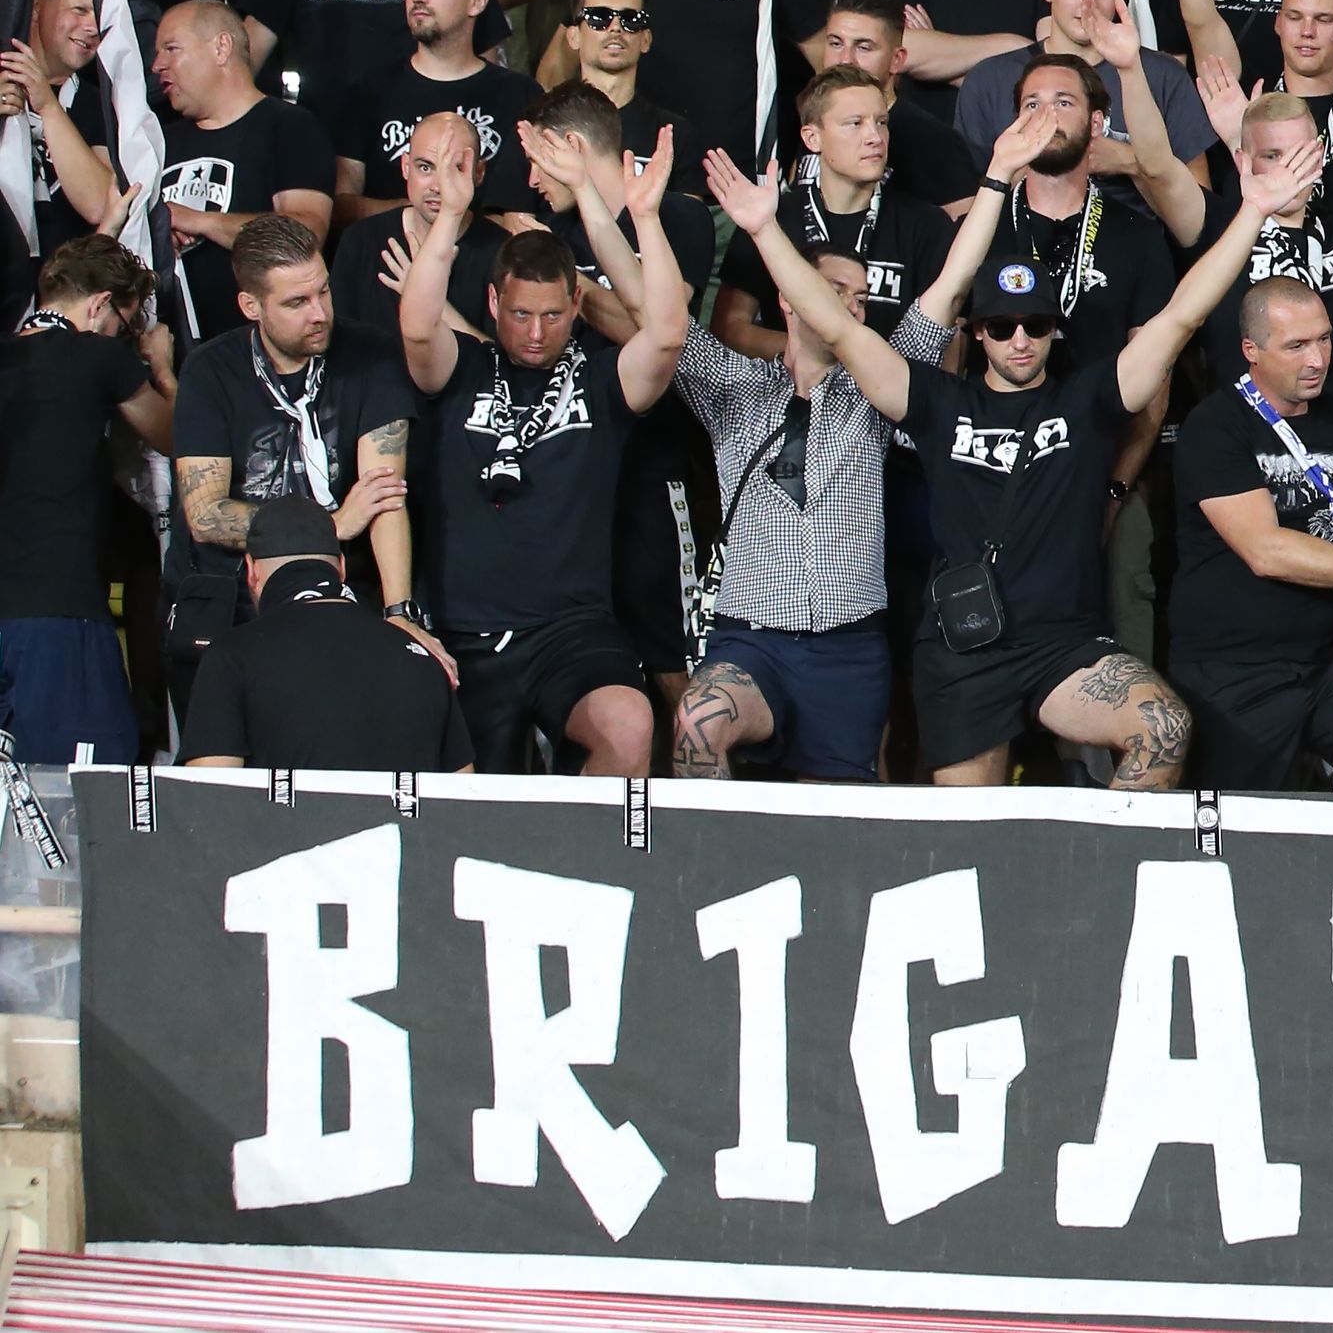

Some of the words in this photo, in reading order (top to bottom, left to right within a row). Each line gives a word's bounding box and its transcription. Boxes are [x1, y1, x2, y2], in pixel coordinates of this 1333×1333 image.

[163, 181, 228, 204] RIGATA
[631, 793, 645, 809] VOM
[631, 810, 645, 834] JUNGS
[631, 834, 645, 848] DIE
